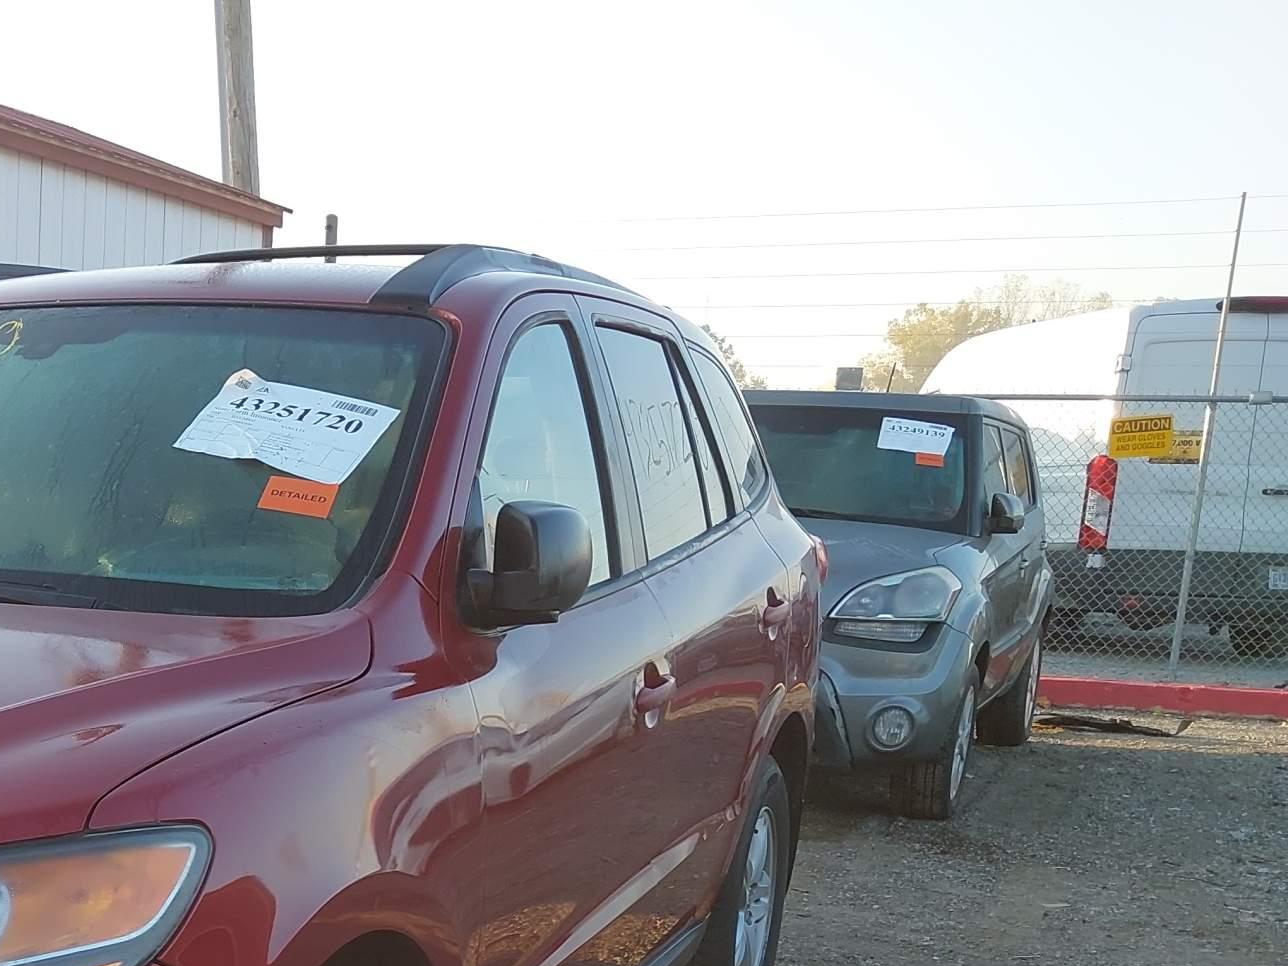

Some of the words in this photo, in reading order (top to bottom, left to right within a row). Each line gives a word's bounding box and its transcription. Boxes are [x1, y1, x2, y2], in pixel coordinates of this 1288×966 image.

[229, 396, 364, 434] 43251720
[888, 424, 946, 438] 43249139
[1113, 419, 1170, 433] CAUTION
[1116, 434, 1137, 444] WEAR
[1138, 432, 1166, 442] GLOVES
[1116, 443, 1131, 451] AND
[1132, 440, 1166, 450] GOGGLES
[270, 488, 328, 504] DETAILED
